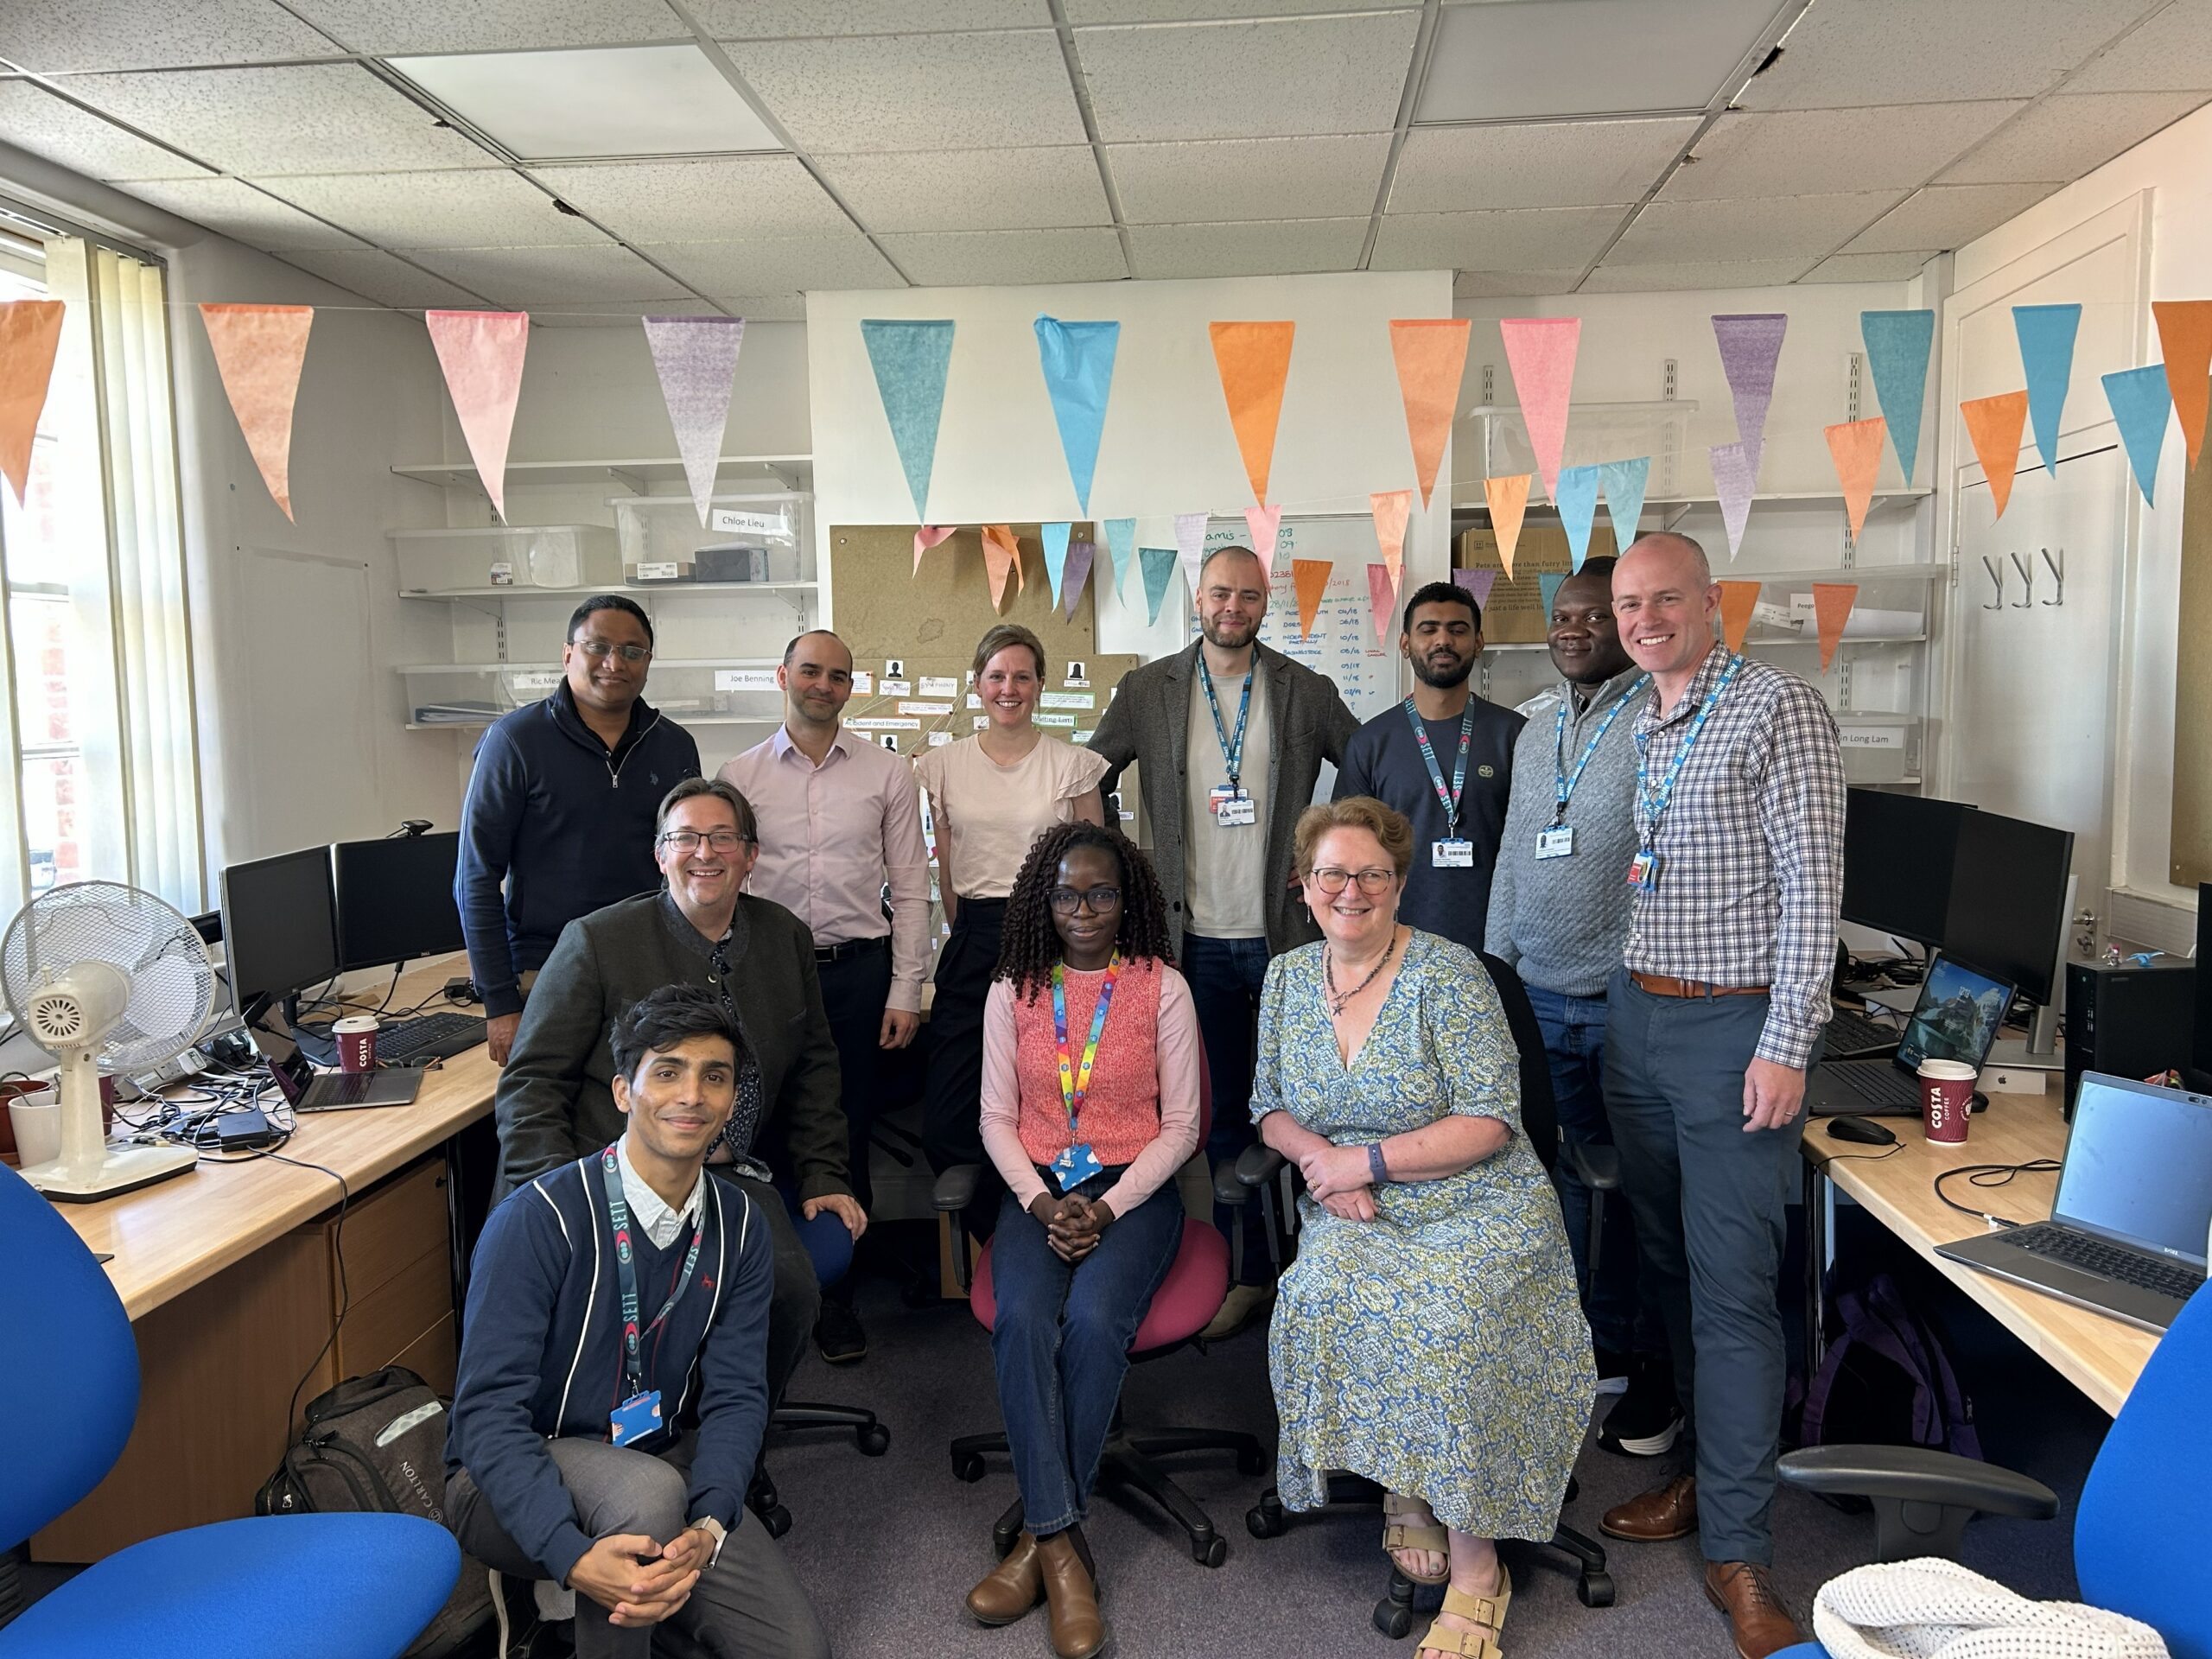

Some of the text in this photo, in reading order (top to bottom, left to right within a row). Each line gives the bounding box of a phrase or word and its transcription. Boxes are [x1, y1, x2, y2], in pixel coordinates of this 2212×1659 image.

[722, 516, 765, 528] Chloe Lieu
[744, 675, 774, 683] Benning
[1725, 664, 1738, 678] NHS
[1626, 684, 1638, 696] NHS
[1712, 681, 1726, 696] NHS
[1613, 699, 1625, 712] NHS
[1700, 701, 1713, 716] NHS
[1462, 718, 1473, 735] SETT
[1602, 714, 1613, 728] NHS
[1592, 731, 1602, 745] NHS
[1689, 721, 1700, 739] NHS
[1850, 735, 1870, 744] Long
[1420, 743, 1436, 760] SETT
[1679, 742, 1690, 759] NHS
[1669, 763, 1680, 779] NHS
[1453, 771, 1465, 790] SETT
[1659, 785, 1669, 801] NHS
[359, 1038, 368, 1067] COSTA
[1930, 1087, 1942, 1128] COSTA
[609, 1201, 628, 1231] SETT
[683, 1245, 700, 1277] SETT
[622, 1293, 638, 1323] SETT
[399, 1461, 432, 1508] CARLTON
